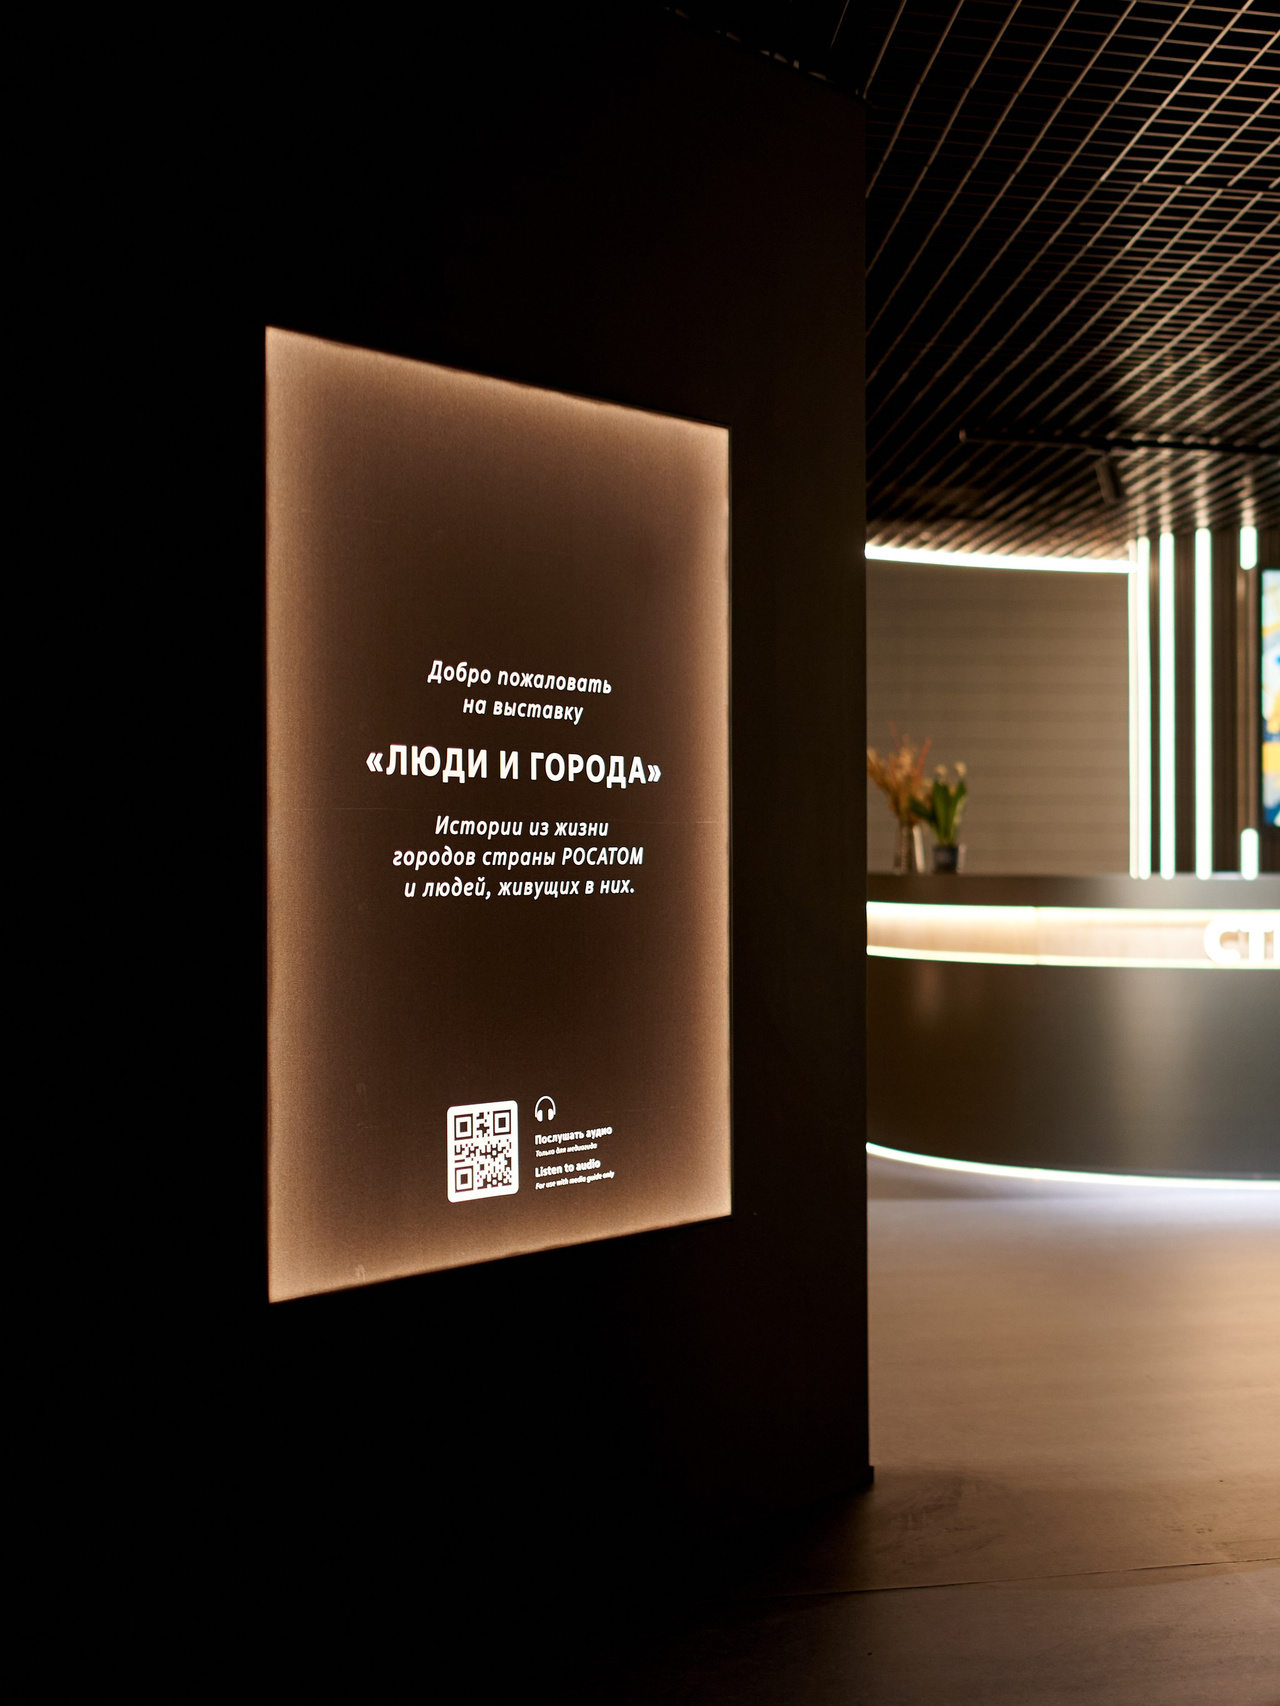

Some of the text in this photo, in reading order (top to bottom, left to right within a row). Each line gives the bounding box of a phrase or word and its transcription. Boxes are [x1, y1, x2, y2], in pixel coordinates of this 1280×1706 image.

[427, 660, 612, 694] Добро пожаловать
[463, 699, 584, 725] на выставку
[366, 744, 662, 789] «ЛЮДИ И ГОРОДА»
[435, 815, 609, 839] Истории из жизни
[393, 846, 644, 870] городов страны РОСАТОМ
[404, 877, 635, 900] и людей, живущих в них.
[535, 1126, 613, 1145] Послушать аудио
[535, 1158, 601, 1177] Listen to audio
[556, 1178, 568, 1186] with
[586, 1173, 602, 1183] guide
[602, 1170, 615, 1179] only
